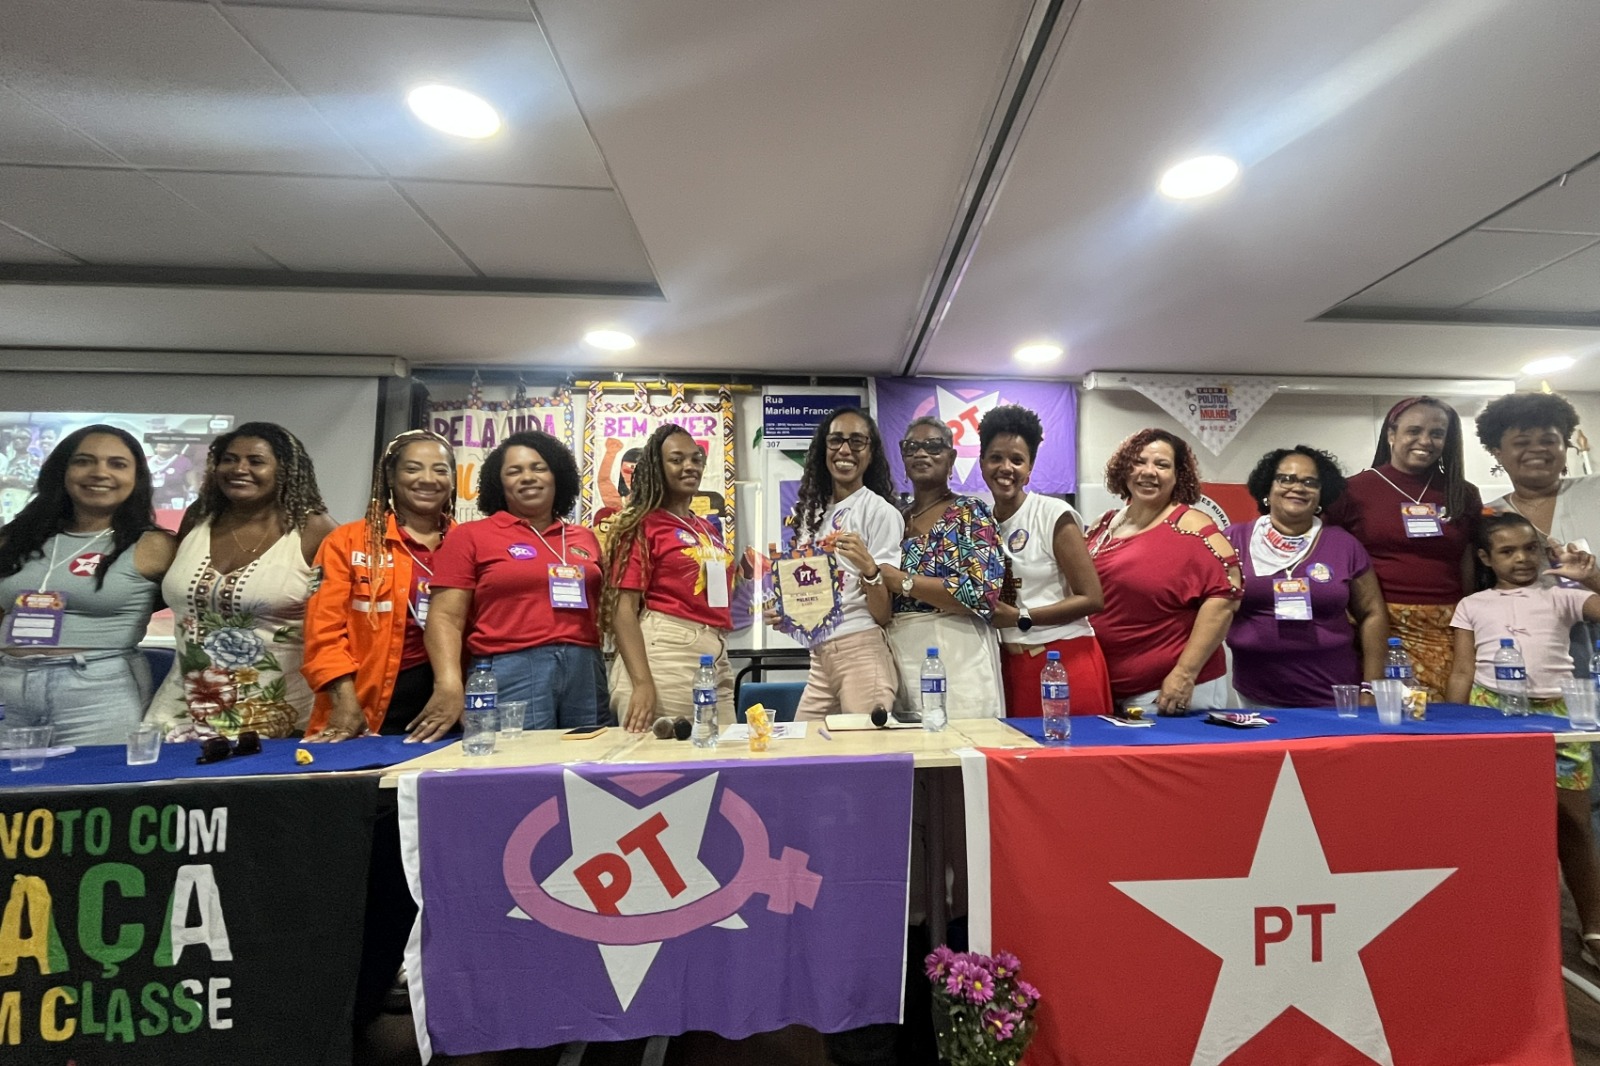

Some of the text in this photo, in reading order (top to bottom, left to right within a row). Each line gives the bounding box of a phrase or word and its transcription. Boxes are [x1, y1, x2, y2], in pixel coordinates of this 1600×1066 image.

[765, 396, 784, 404] Rua
[765, 407, 801, 415] Marielle
[434, 415, 497, 448] PELA
[604, 416, 648, 437] BEM
[946, 405, 980, 446] PT
[1200, 496, 1212, 507] ES
[800, 571, 811, 582] PT
[0, 804, 229, 860] VOTO COM
[573, 811, 688, 916] PT
[1254, 903, 1337, 966] PT
[40, 977, 233, 1043] CLASSE
